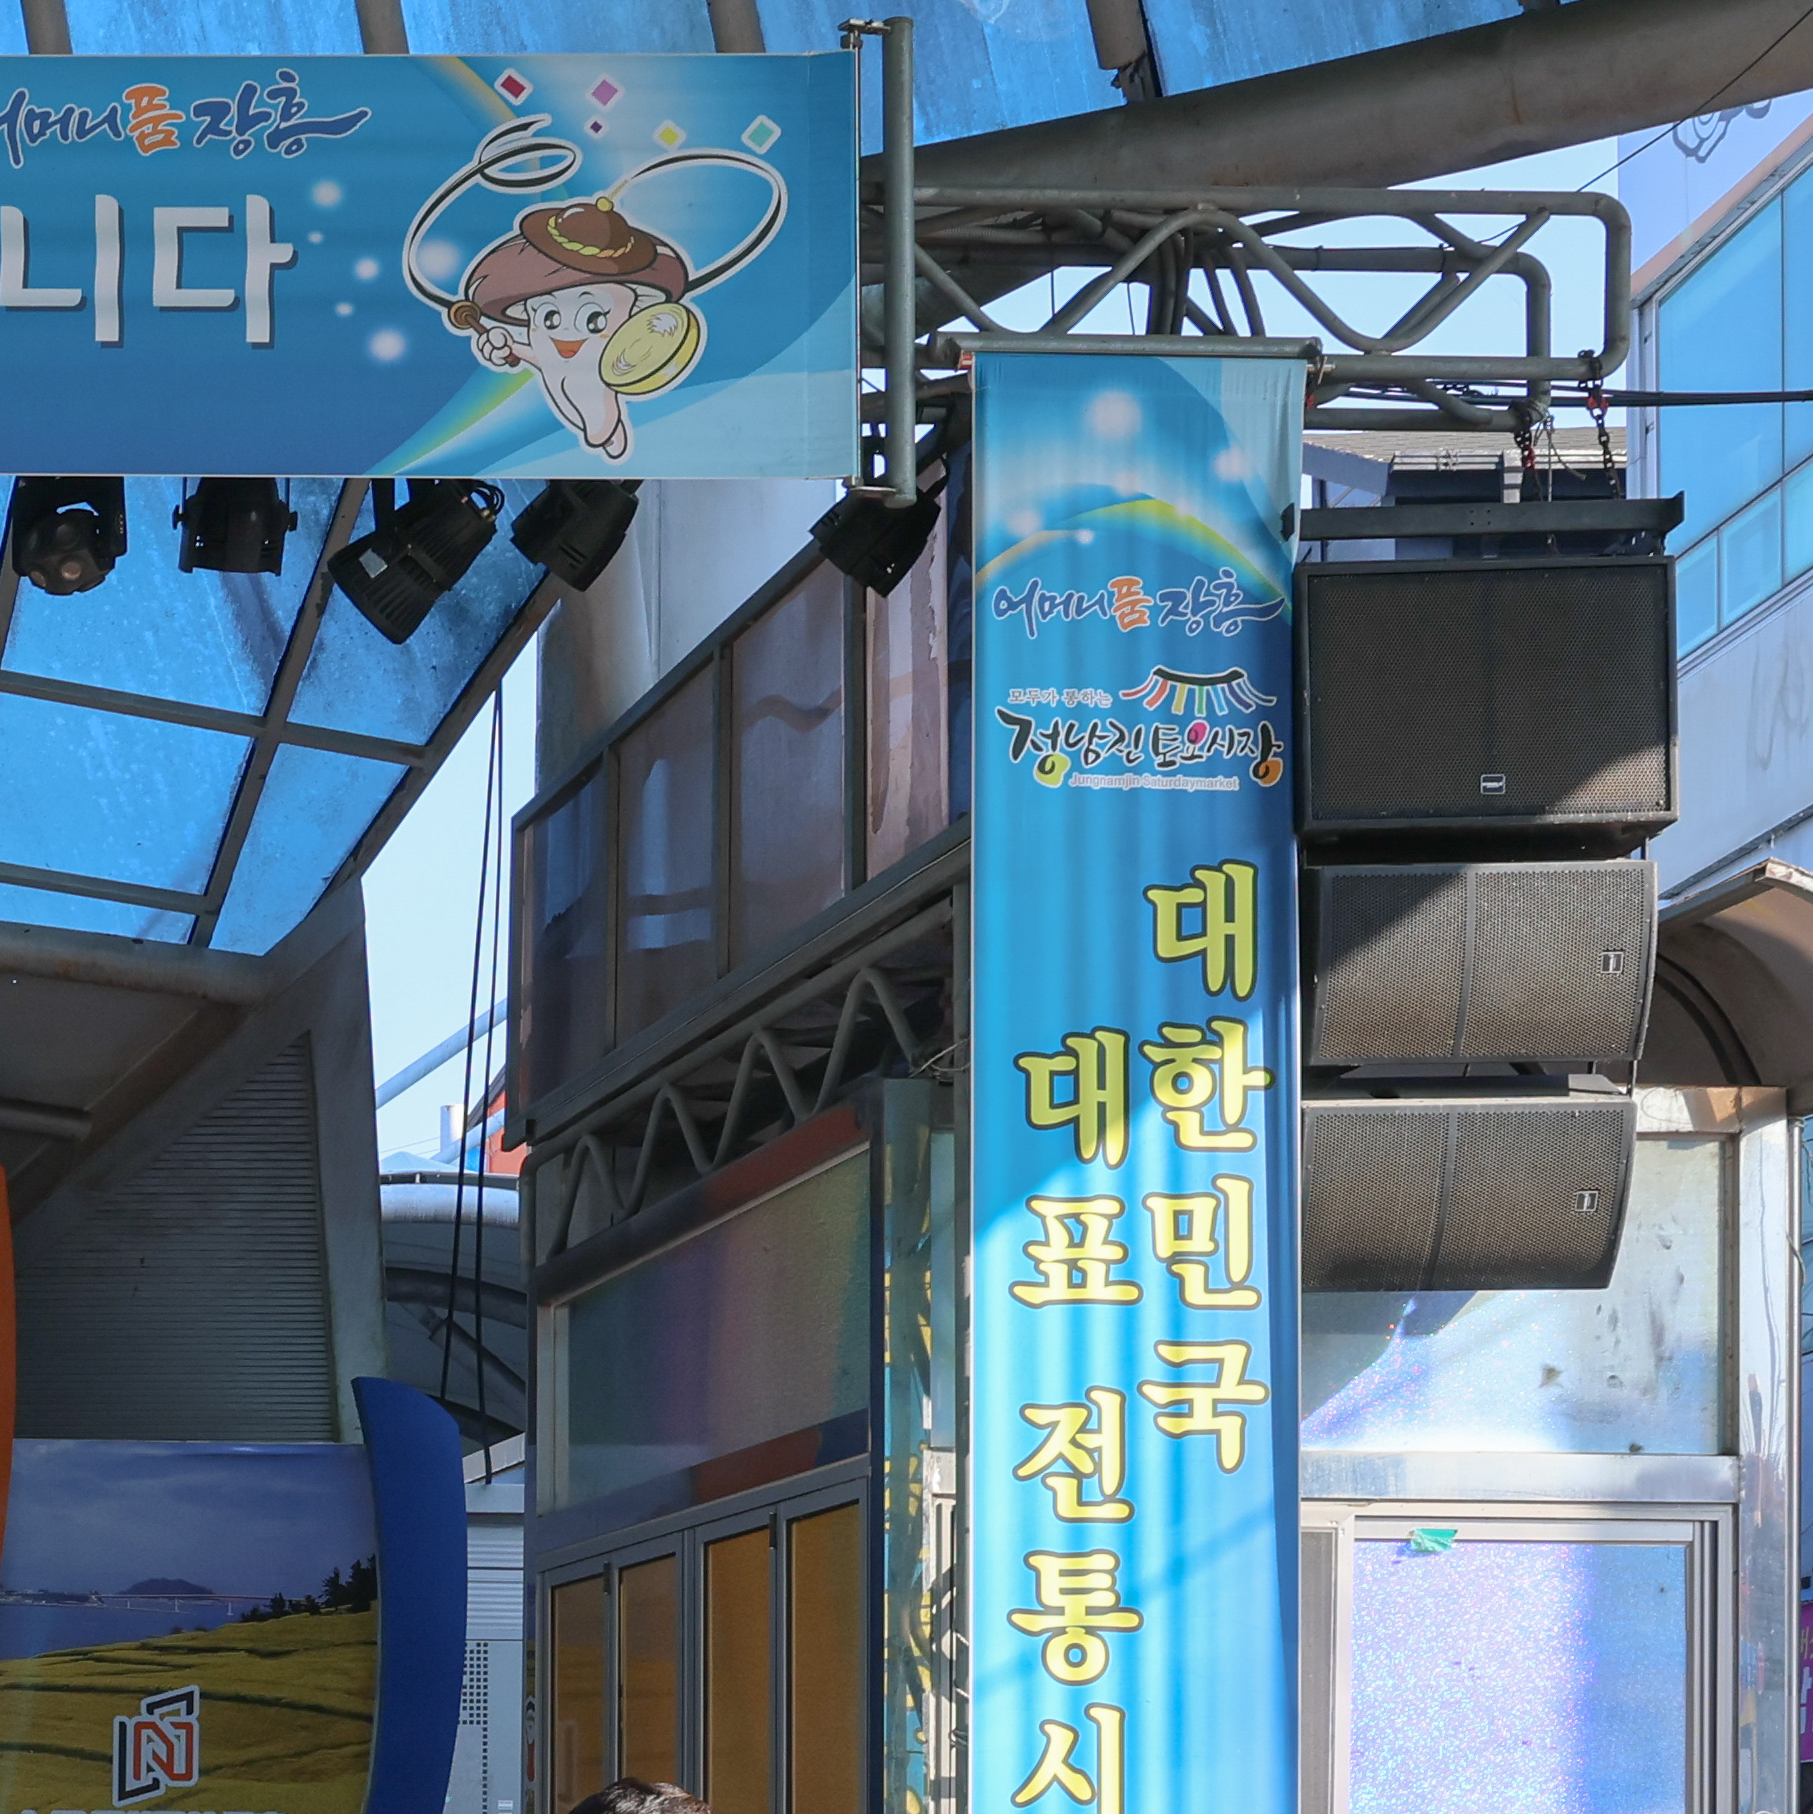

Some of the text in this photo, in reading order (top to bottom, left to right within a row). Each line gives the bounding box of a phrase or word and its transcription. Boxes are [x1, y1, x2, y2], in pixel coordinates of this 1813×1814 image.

[1009, 689, 1113, 707] 모두가 통하는
[996, 707, 1283, 786] 정남진 토요시장
[1070, 773, 1140, 789] Jungnamjin
[1008, 1025, 1144, 1307] 대표
[1138, 857, 1275, 1473] 대한민국
